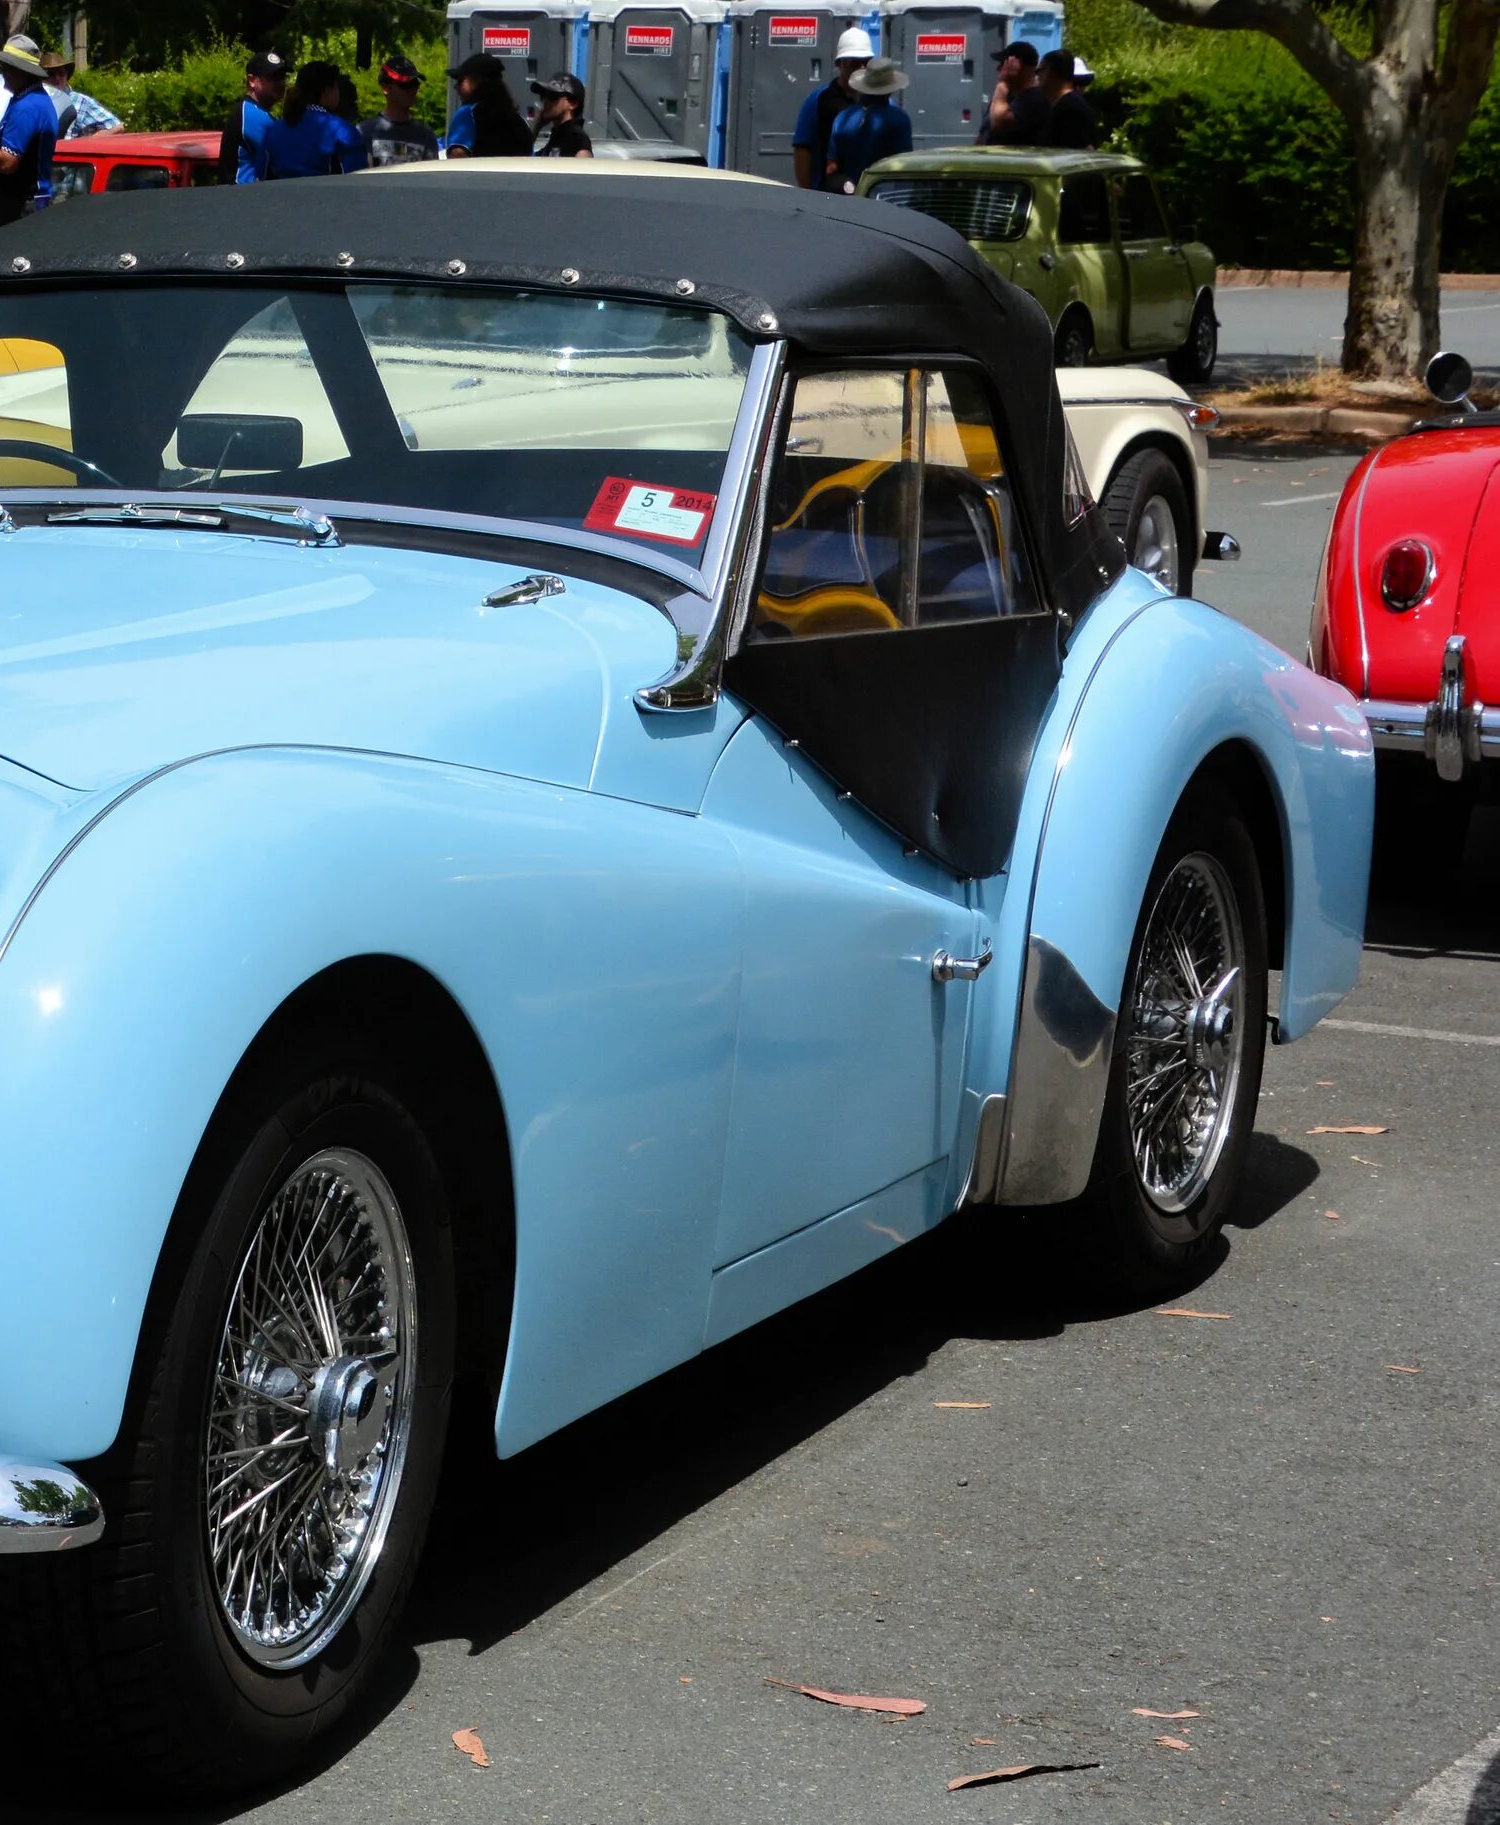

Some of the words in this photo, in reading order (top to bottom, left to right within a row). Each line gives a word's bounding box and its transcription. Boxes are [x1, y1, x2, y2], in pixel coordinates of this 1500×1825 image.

[771, 26, 815, 35] KENNARDS
[484, 37, 527, 46] KENNARDS
[628, 36, 670, 45] KENNARDS
[653, 47, 669, 55] HIRE
[918, 43, 963, 52] KENNARDS
[641, 492, 657, 508] 5
[676, 495, 712, 511] 2014
